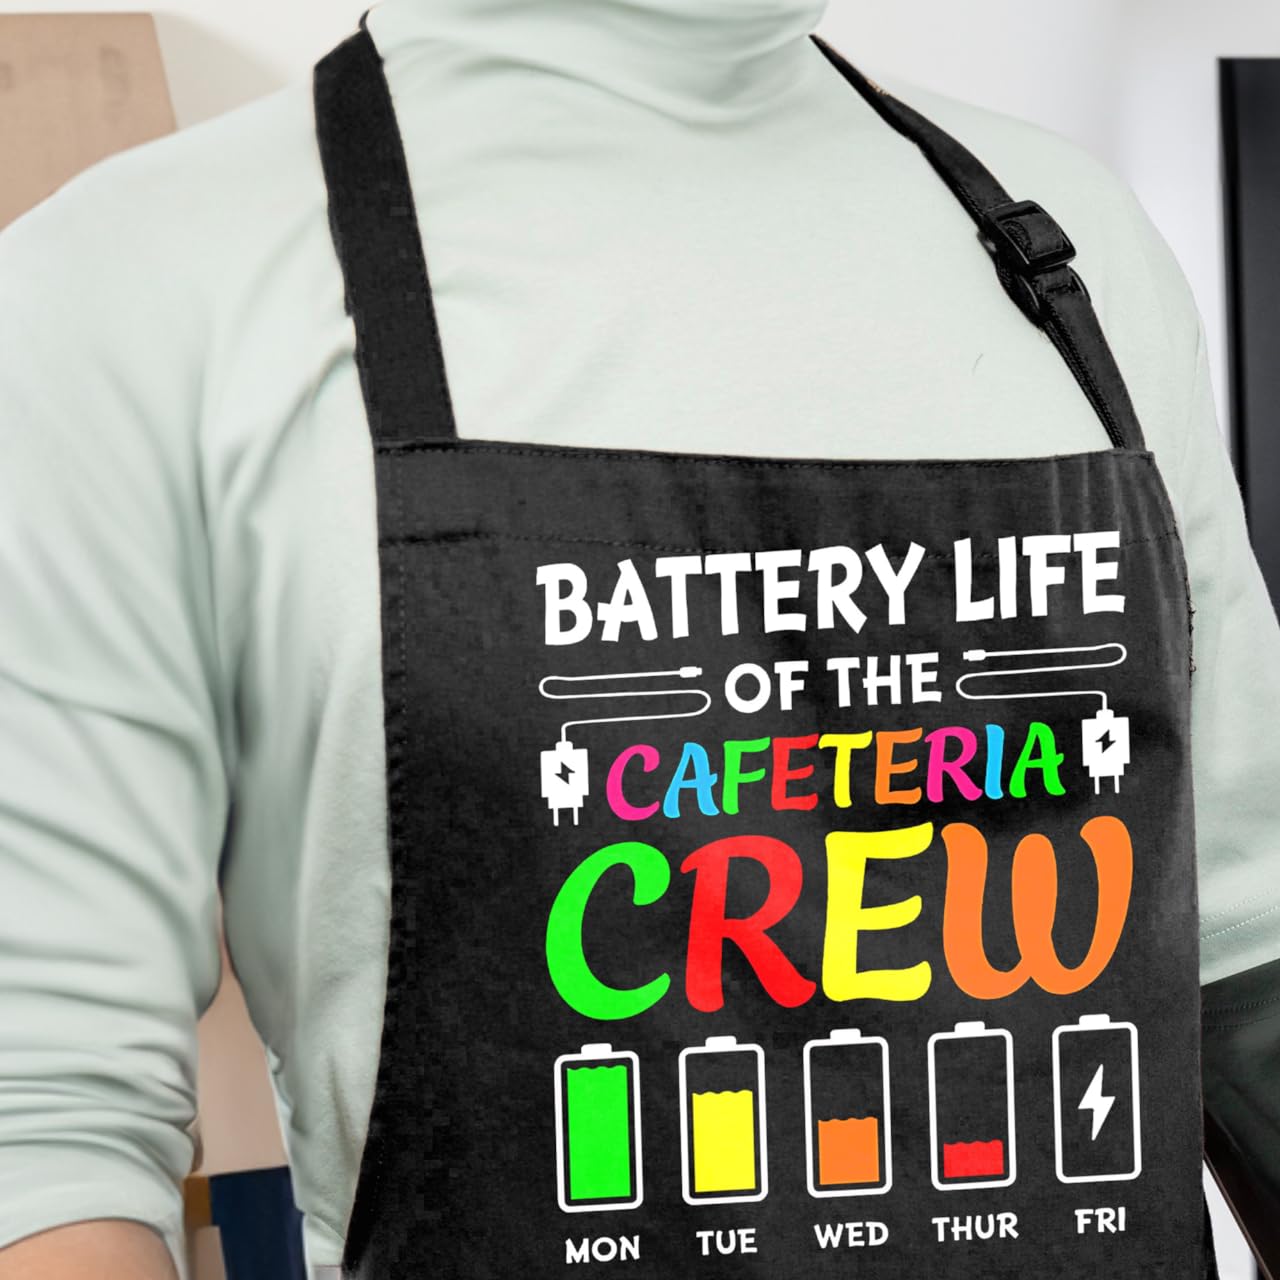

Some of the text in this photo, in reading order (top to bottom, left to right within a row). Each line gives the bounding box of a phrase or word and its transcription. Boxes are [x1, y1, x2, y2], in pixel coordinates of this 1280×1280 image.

[536, 531, 1126, 645] BATTERY LIFE
[725, 652, 943, 713] OF THE
[605, 721, 1066, 821] CAFETERIA
[545, 815, 1134, 1021] CREW
[565, 1207, 1126, 1264] MON TUE WED THUR FRI
